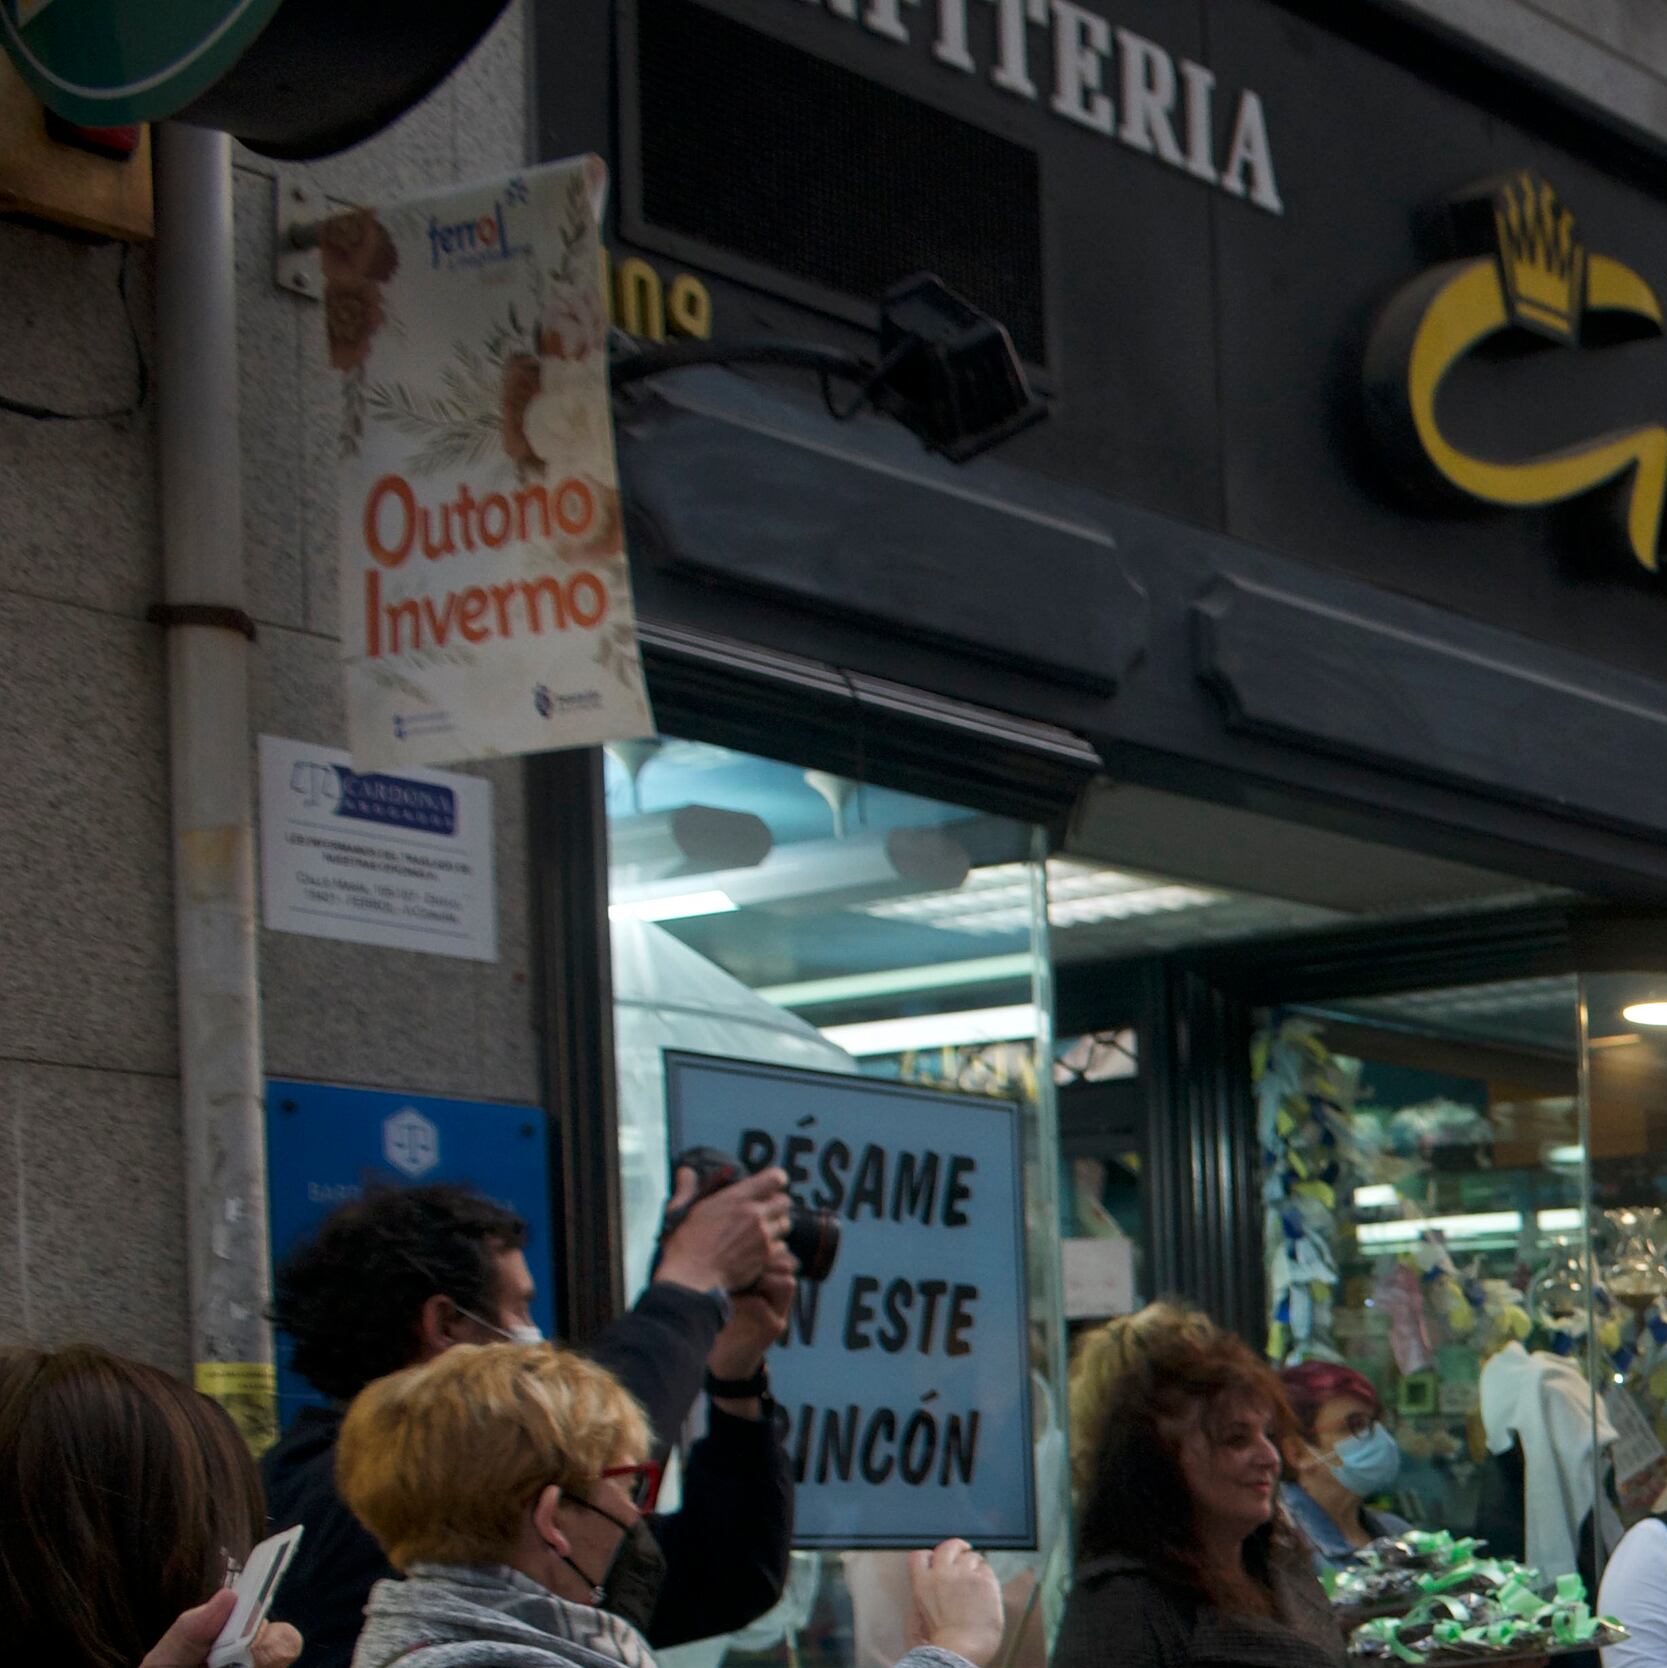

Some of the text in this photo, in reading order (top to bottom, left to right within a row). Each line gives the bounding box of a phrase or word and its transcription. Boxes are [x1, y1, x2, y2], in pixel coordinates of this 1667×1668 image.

[363, 474, 595, 568] Outono
[364, 569, 609, 660] Inverno
[843, 1275, 979, 1357] ESTE
